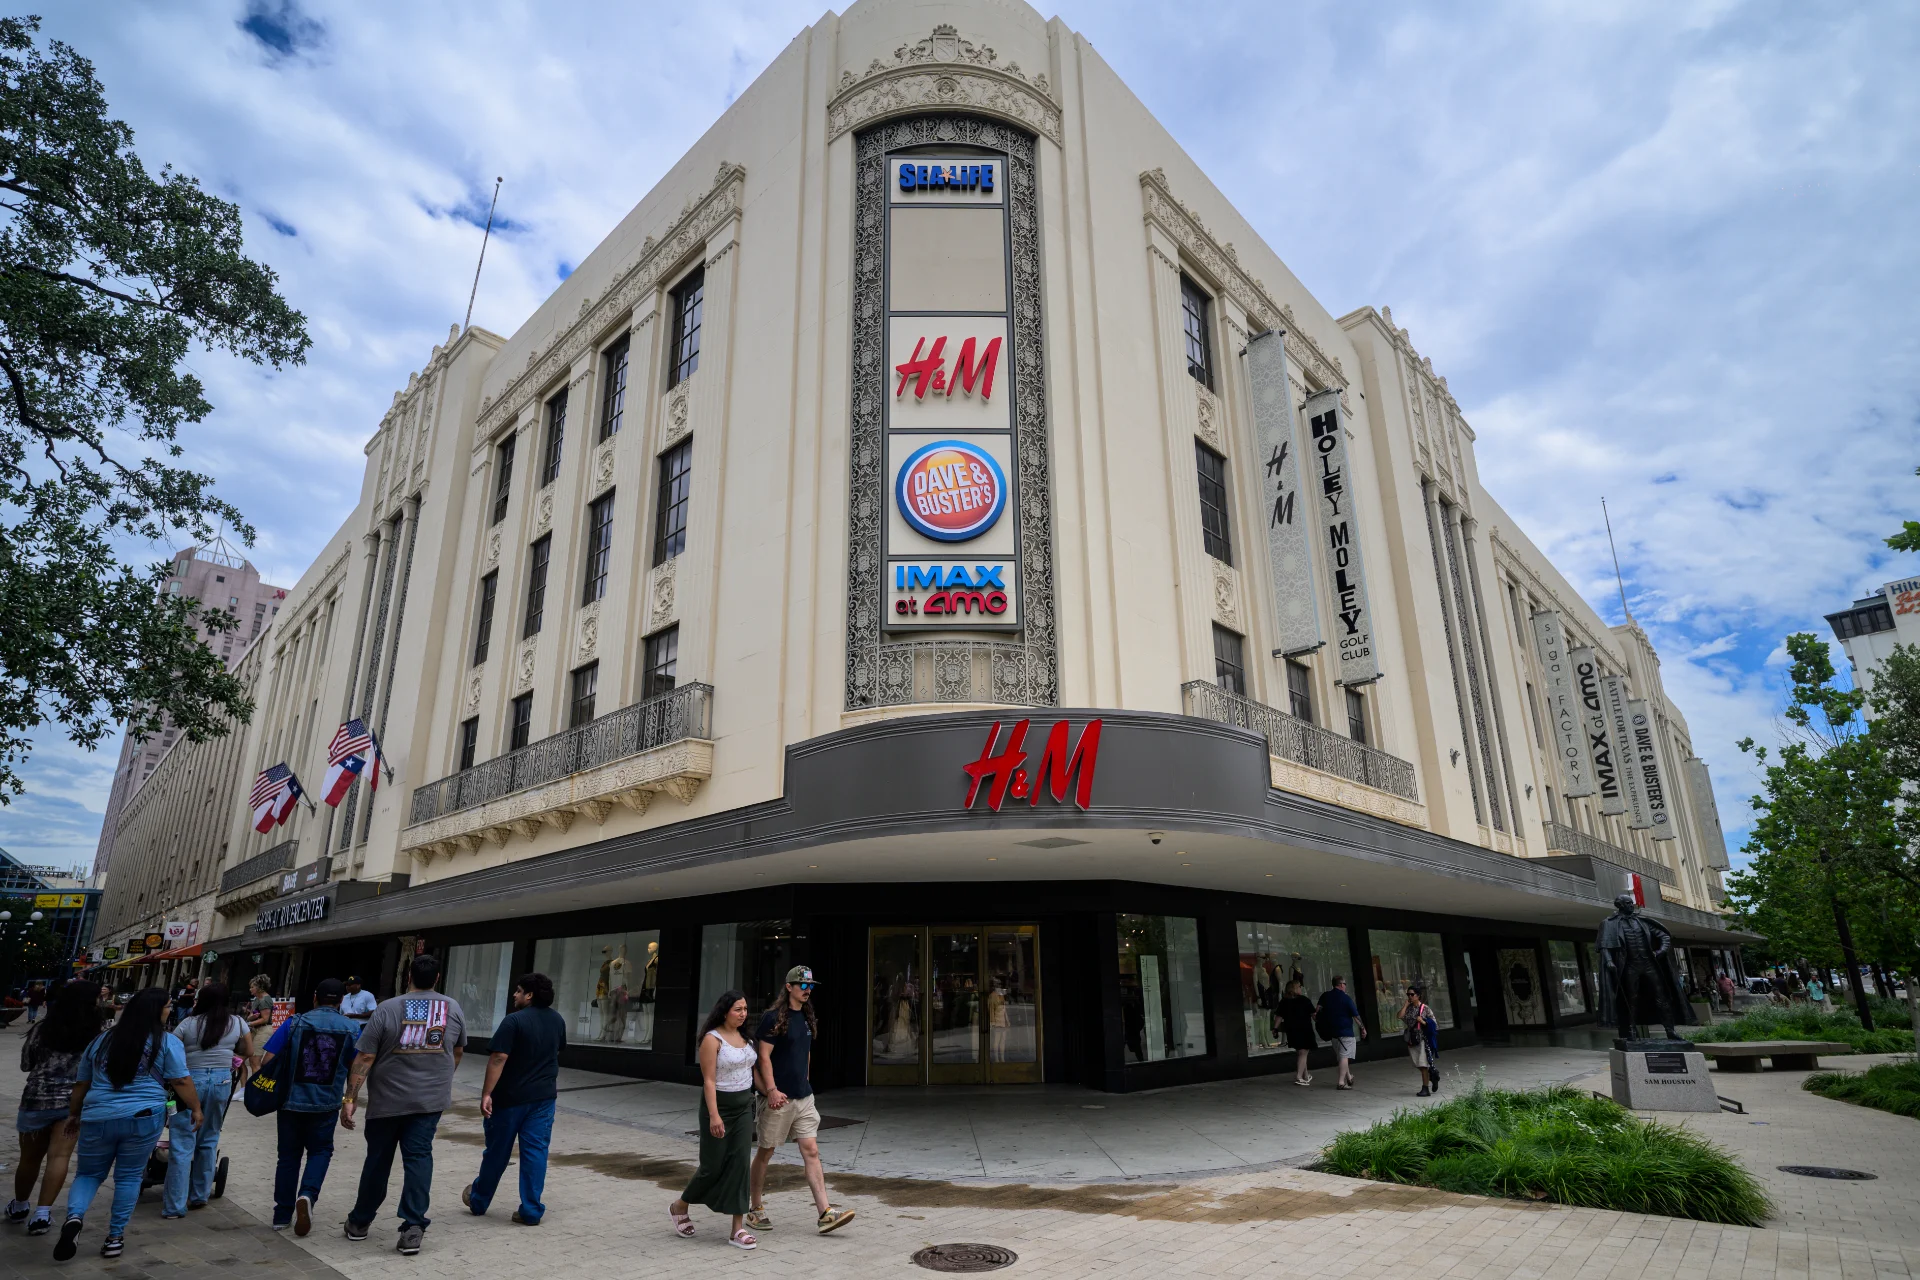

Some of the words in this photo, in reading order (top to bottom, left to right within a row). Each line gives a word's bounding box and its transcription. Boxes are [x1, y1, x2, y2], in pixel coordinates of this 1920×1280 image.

[899, 164, 945, 192] SEA
[896, 336, 1003, 402] H&M
[914, 463, 971, 495] DAVE
[969, 462, 989, 485] &
[916, 484, 992, 516] BUSTER'S
[1311, 409, 1341, 517] HOLEY
[1329, 521, 1362, 636] MOLEY
[896, 566, 1006, 590] IMAX
[895, 596, 918, 615] at
[924, 591, 1008, 615] amc
[1339, 634, 1369, 649] GOLF
[1341, 646, 1371, 661] CLUB
[1577, 662, 1600, 711] amc
[1591, 714, 1604, 728] at
[1559, 695, 1580, 784] FACTORY
[1608, 681, 1622, 715] BATTLE
[1615, 715, 1625, 733] FOR
[1620, 734, 1632, 764] TEXAS
[1629, 782, 1642, 824] EXPERIENCE
[1635, 728, 1652, 752] DAVE
[963, 719, 1102, 812] H&M
[1590, 730, 1619, 798] IMAX
[1640, 755, 1654, 763] &
[1642, 764, 1665, 810] BUSTER'S
